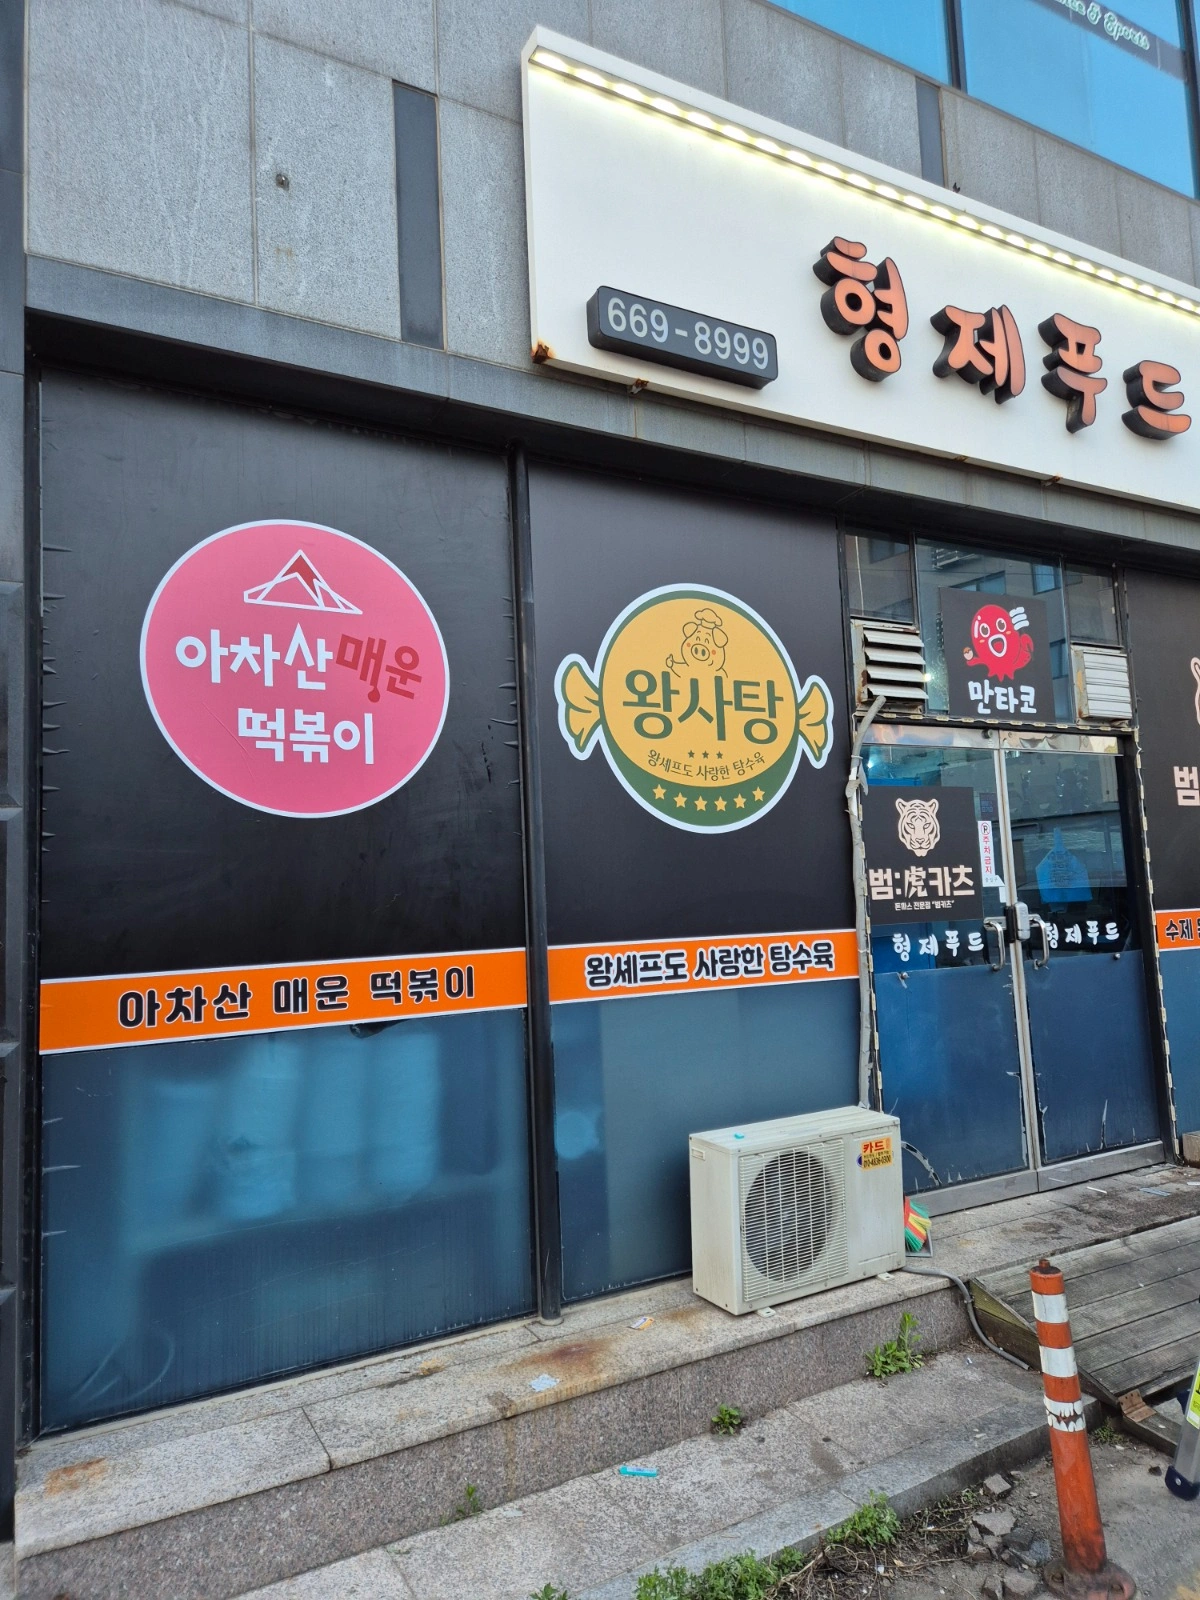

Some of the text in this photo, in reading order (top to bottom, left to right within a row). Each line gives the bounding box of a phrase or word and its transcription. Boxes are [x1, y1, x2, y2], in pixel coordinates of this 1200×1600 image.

[1104, 11, 1150, 50] Sports
[607, 297, 769, 370] 669-8999
[812, 235, 1192, 441] 형제푸드
[175, 622, 422, 703] 아차산 매운
[622, 669, 784, 745] 왕사탕
[968, 679, 1037, 714] 만타코
[238, 707, 374, 765] 떡볶이
[696, 764, 730, 782] 사랑한
[732, 751, 766, 777] 탕수육
[982, 835, 992, 875] 주차금지
[892, 930, 985, 962] 형제푸드
[1165, 918, 1194, 942] 수제
[694, 944, 764, 979] 사랑한
[769, 940, 835, 973] 탕수육
[118, 964, 476, 1028] 아차산 매운 떡볶이
[863, 1140, 885, 1153] 카드
